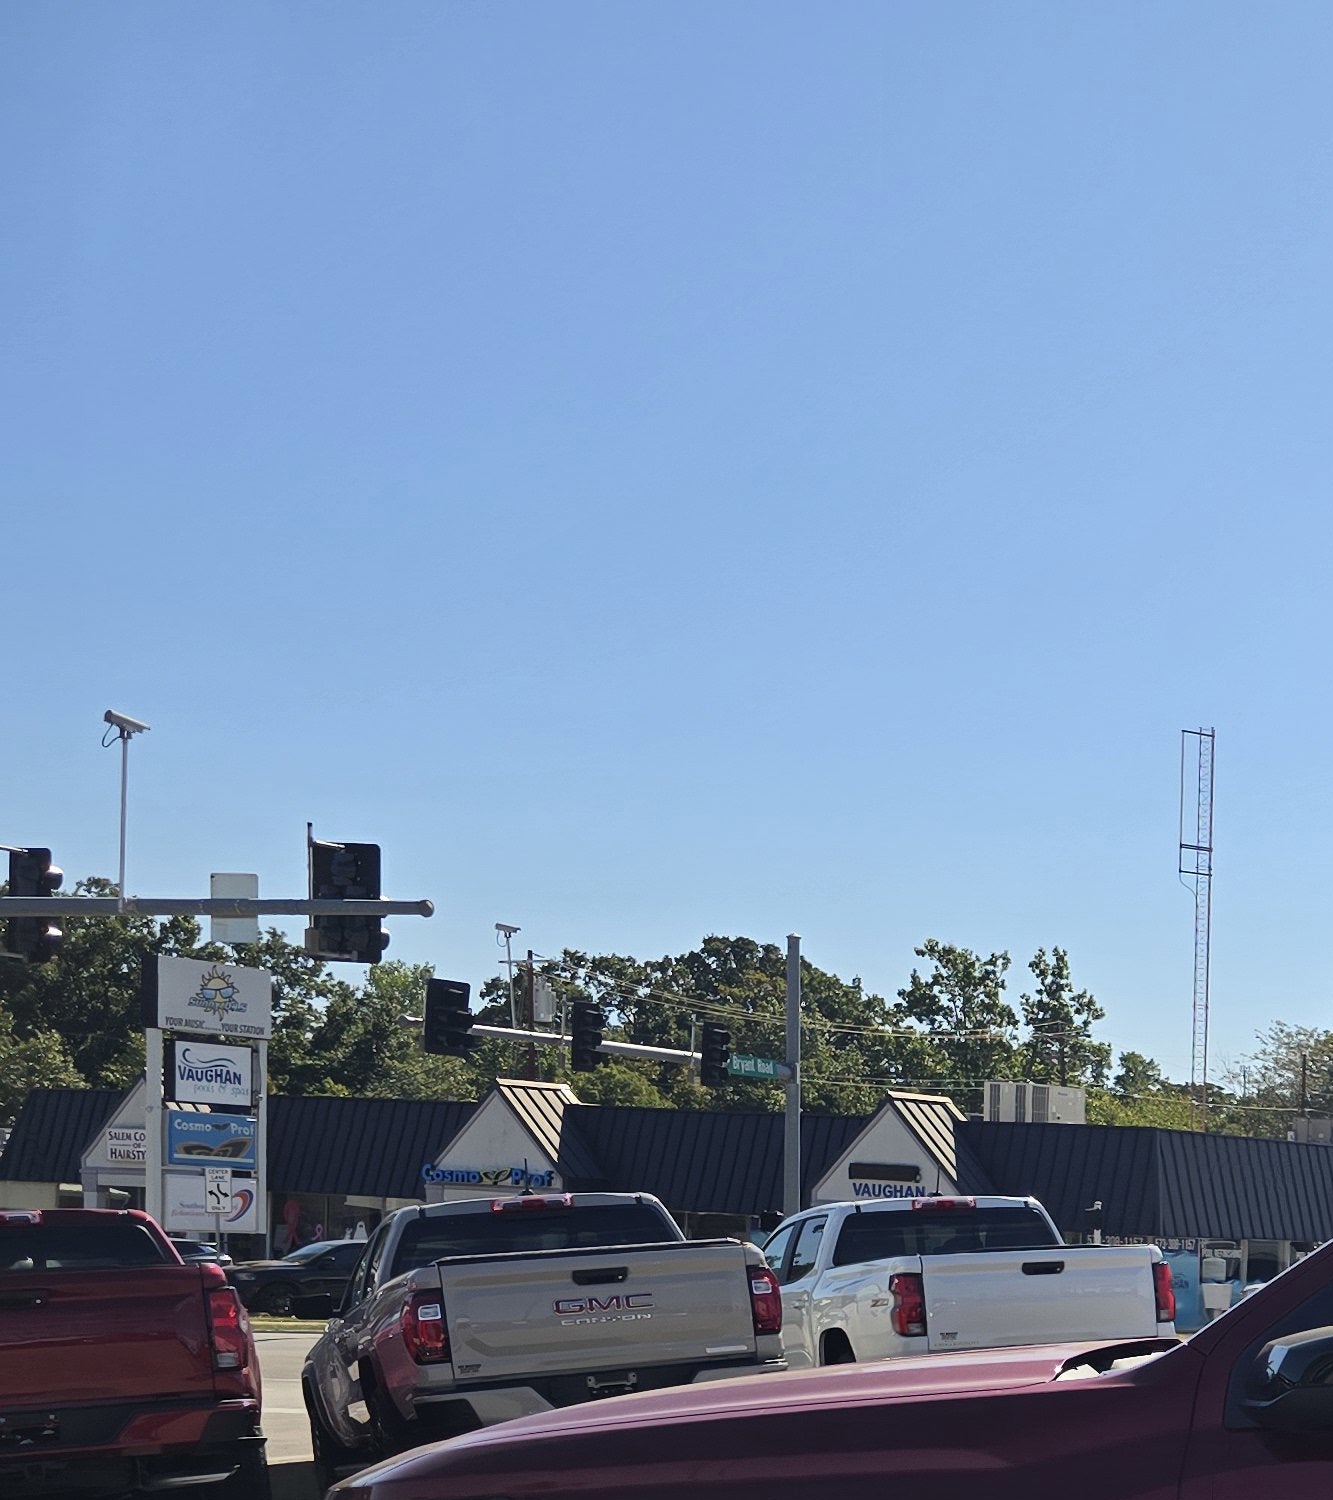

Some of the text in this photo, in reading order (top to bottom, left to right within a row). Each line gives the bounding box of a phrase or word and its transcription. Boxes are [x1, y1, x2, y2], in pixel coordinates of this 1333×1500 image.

[165, 1016, 184, 1027] YOUR
[221, 1023, 239, 1033] YOUR
[239, 1024, 265, 1035] STATION
[732, 1055, 774, 1075] Bryant Road
[177, 1064, 242, 1086] VAUGHAN
[193, 1083, 215, 1094] pools
[231, 1087, 249, 1098] spas
[108, 1130, 132, 1142] SALEM
[174, 1118, 255, 1136] Cosmo Prof
[421, 1163, 481, 1183] Cosmo
[852, 1182, 926, 1199] VAUGHAN
[1087, 1234, 1144, 1246] 5-308-1157
[553, 1292, 656, 1316] GMC
[561, 1313, 652, 1326] CANYON
